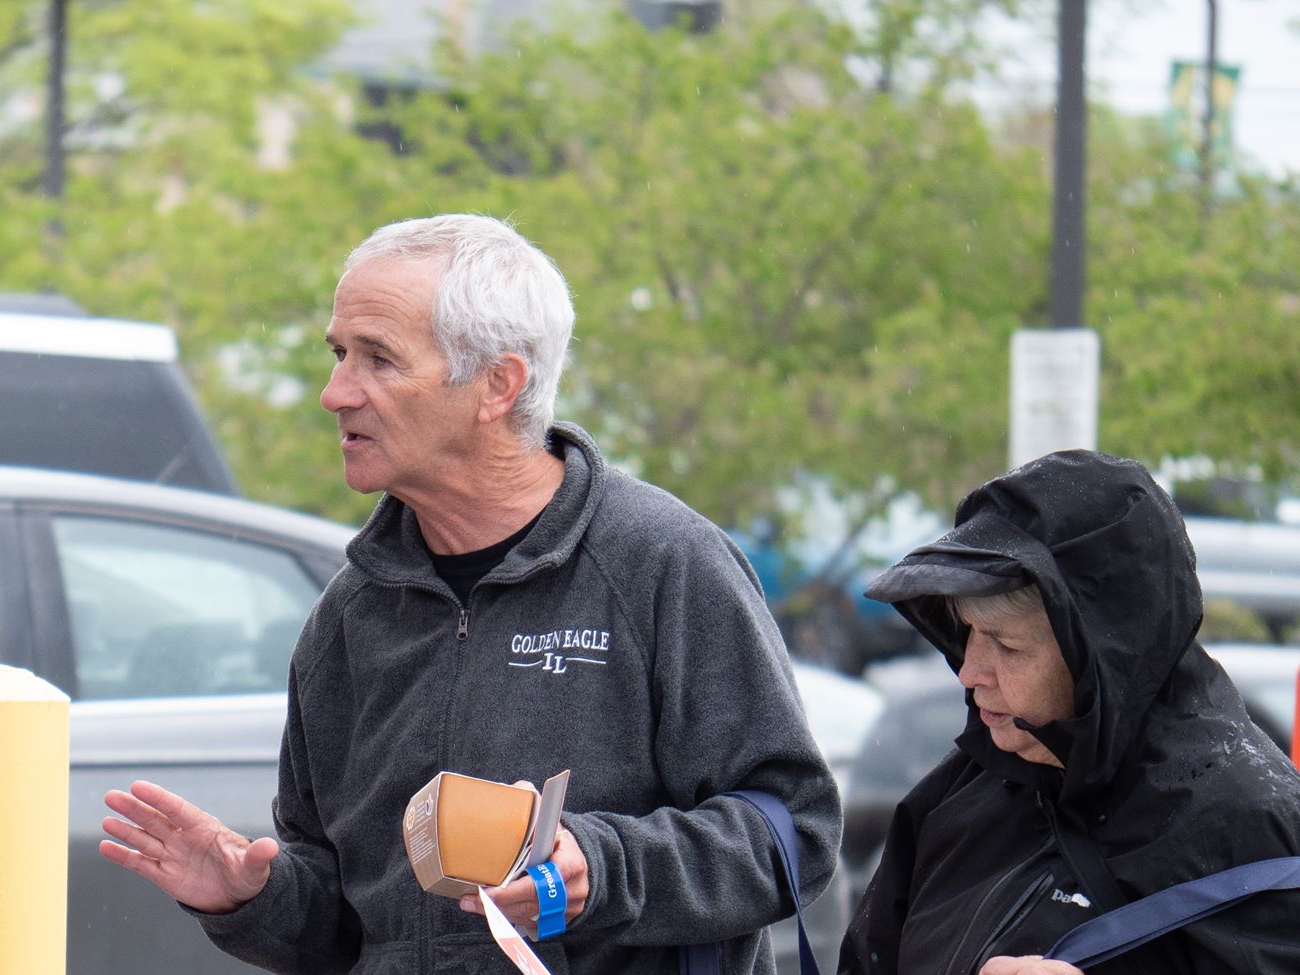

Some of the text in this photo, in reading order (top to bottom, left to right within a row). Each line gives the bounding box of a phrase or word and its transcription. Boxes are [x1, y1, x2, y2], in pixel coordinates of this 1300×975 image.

[511, 629, 610, 653] GOLDEN EAGLE
[542, 652, 567, 674] IL
